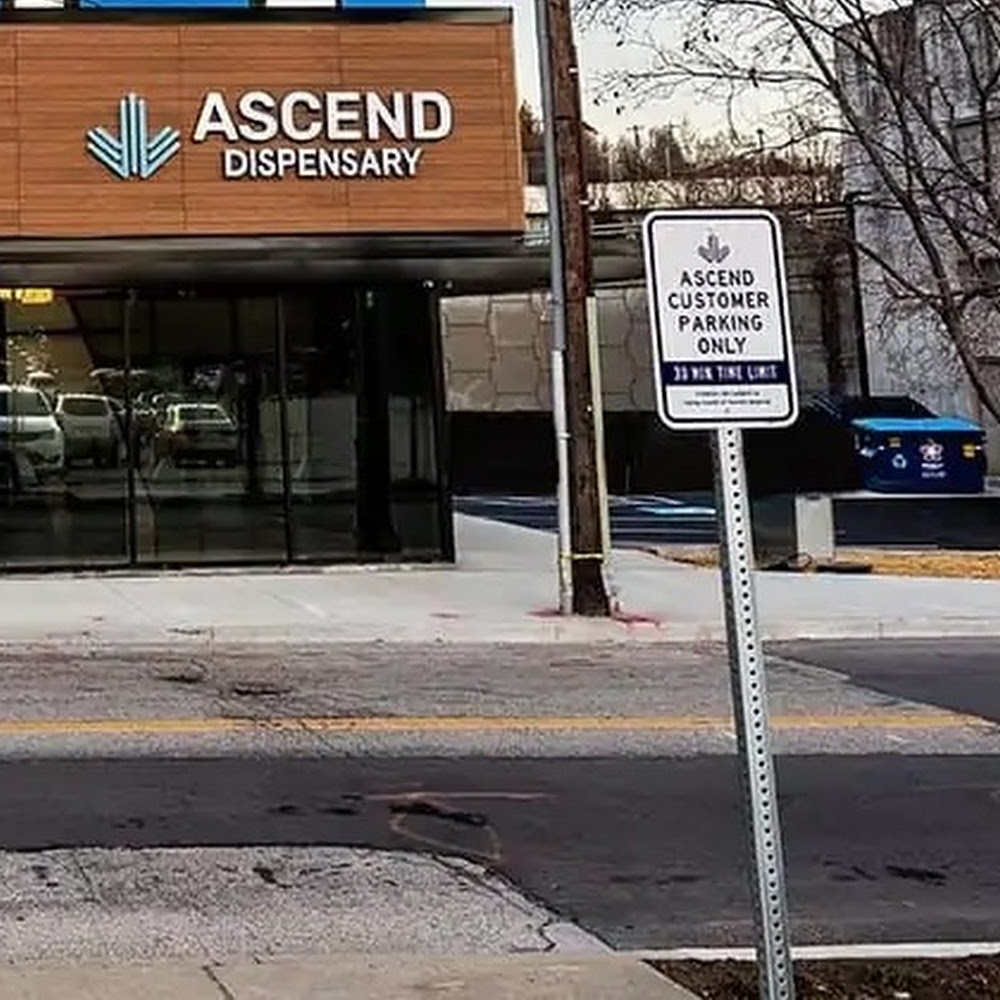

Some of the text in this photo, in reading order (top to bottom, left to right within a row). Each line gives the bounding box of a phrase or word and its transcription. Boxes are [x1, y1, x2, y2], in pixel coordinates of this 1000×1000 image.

[193, 91, 453, 141] ASCEND
[224, 149, 422, 178] DISPENSARY
[680, 270, 754, 287] ASCEND
[668, 291, 769, 309] CUSTOMER
[678, 315, 763, 332] PARKING
[697, 337, 746, 355] ONLY
